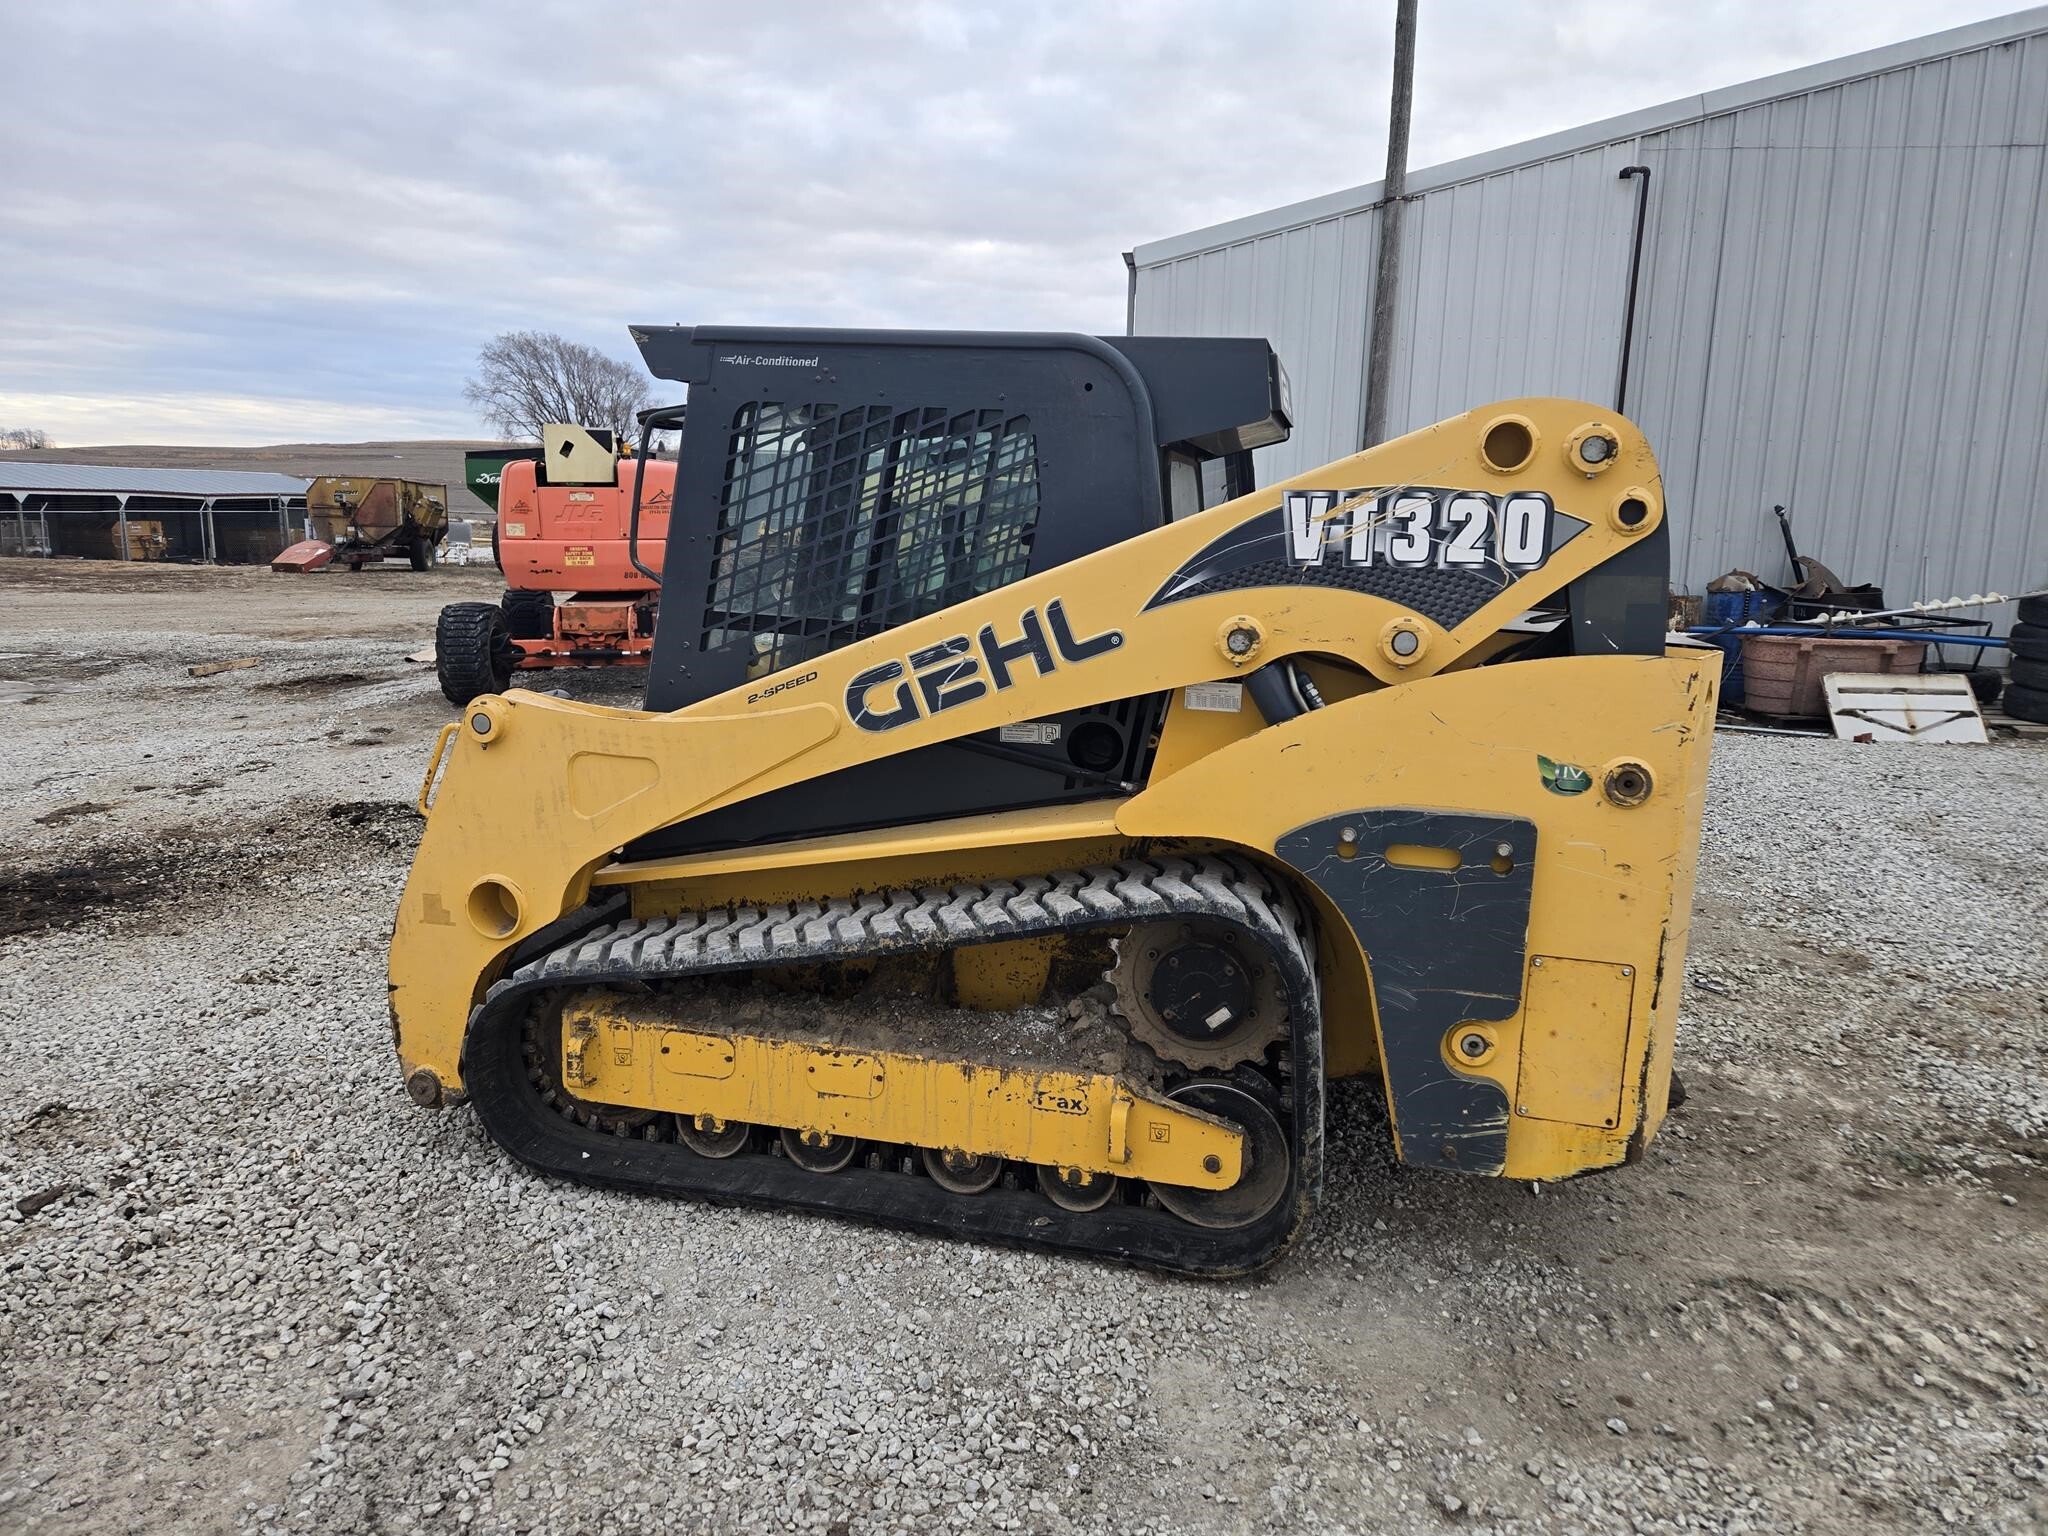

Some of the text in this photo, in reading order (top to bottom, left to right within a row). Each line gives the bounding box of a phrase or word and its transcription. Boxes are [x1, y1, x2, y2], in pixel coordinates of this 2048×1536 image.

[735, 355, 819, 367] Air-Conditioned
[553, 504, 604, 524] JLG
[1283, 490, 1554, 570] VT320
[844, 597, 1124, 733] GEHL
[747, 671, 818, 705] 2-SPEED
